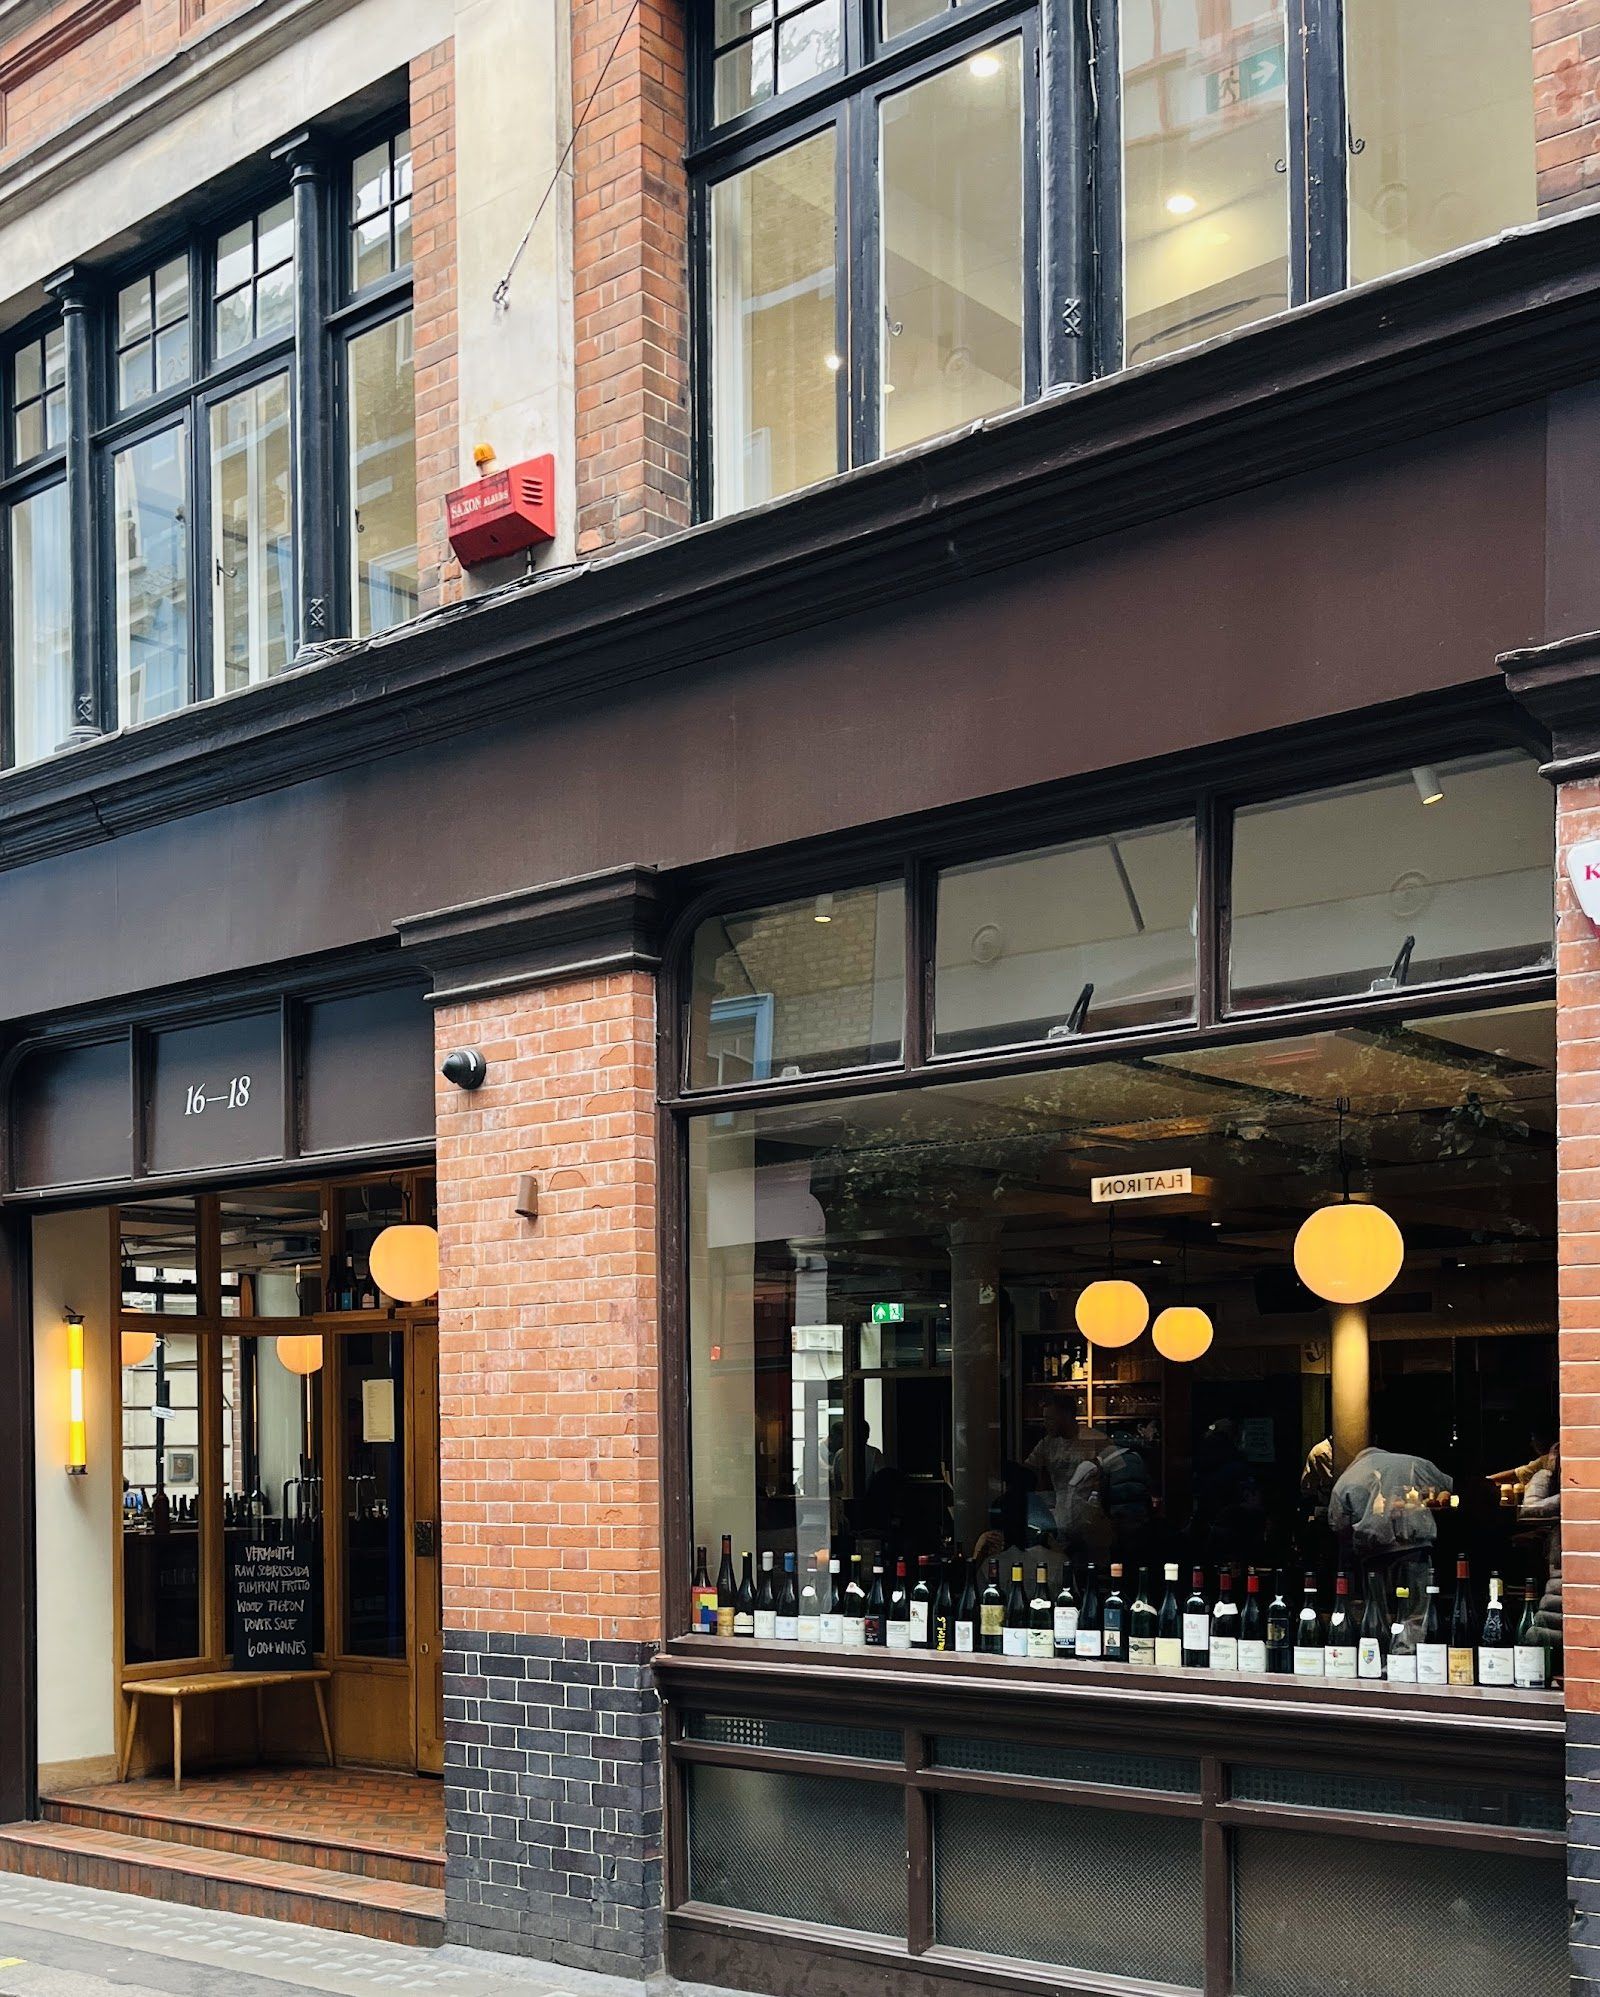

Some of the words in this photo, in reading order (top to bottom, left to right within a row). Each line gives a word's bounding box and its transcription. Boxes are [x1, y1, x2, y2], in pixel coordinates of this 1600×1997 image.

[451, 495, 482, 519] SAXON
[483, 489, 509, 507] ALARMS
[245, 1545, 295, 1562] VERMOUTH
[234, 1564, 255, 1577] RAW
[257, 1564, 310, 1578] SOBRASSADA
[238, 1580, 279, 1594] PUMPKIN
[281, 1580, 310, 1593] FRITTO
[236, 1599, 263, 1613] WOOD
[267, 1599, 305, 1612] PIGEON
[244, 1617, 272, 1632] DOVER
[274, 1617, 298, 1631] SOLE
